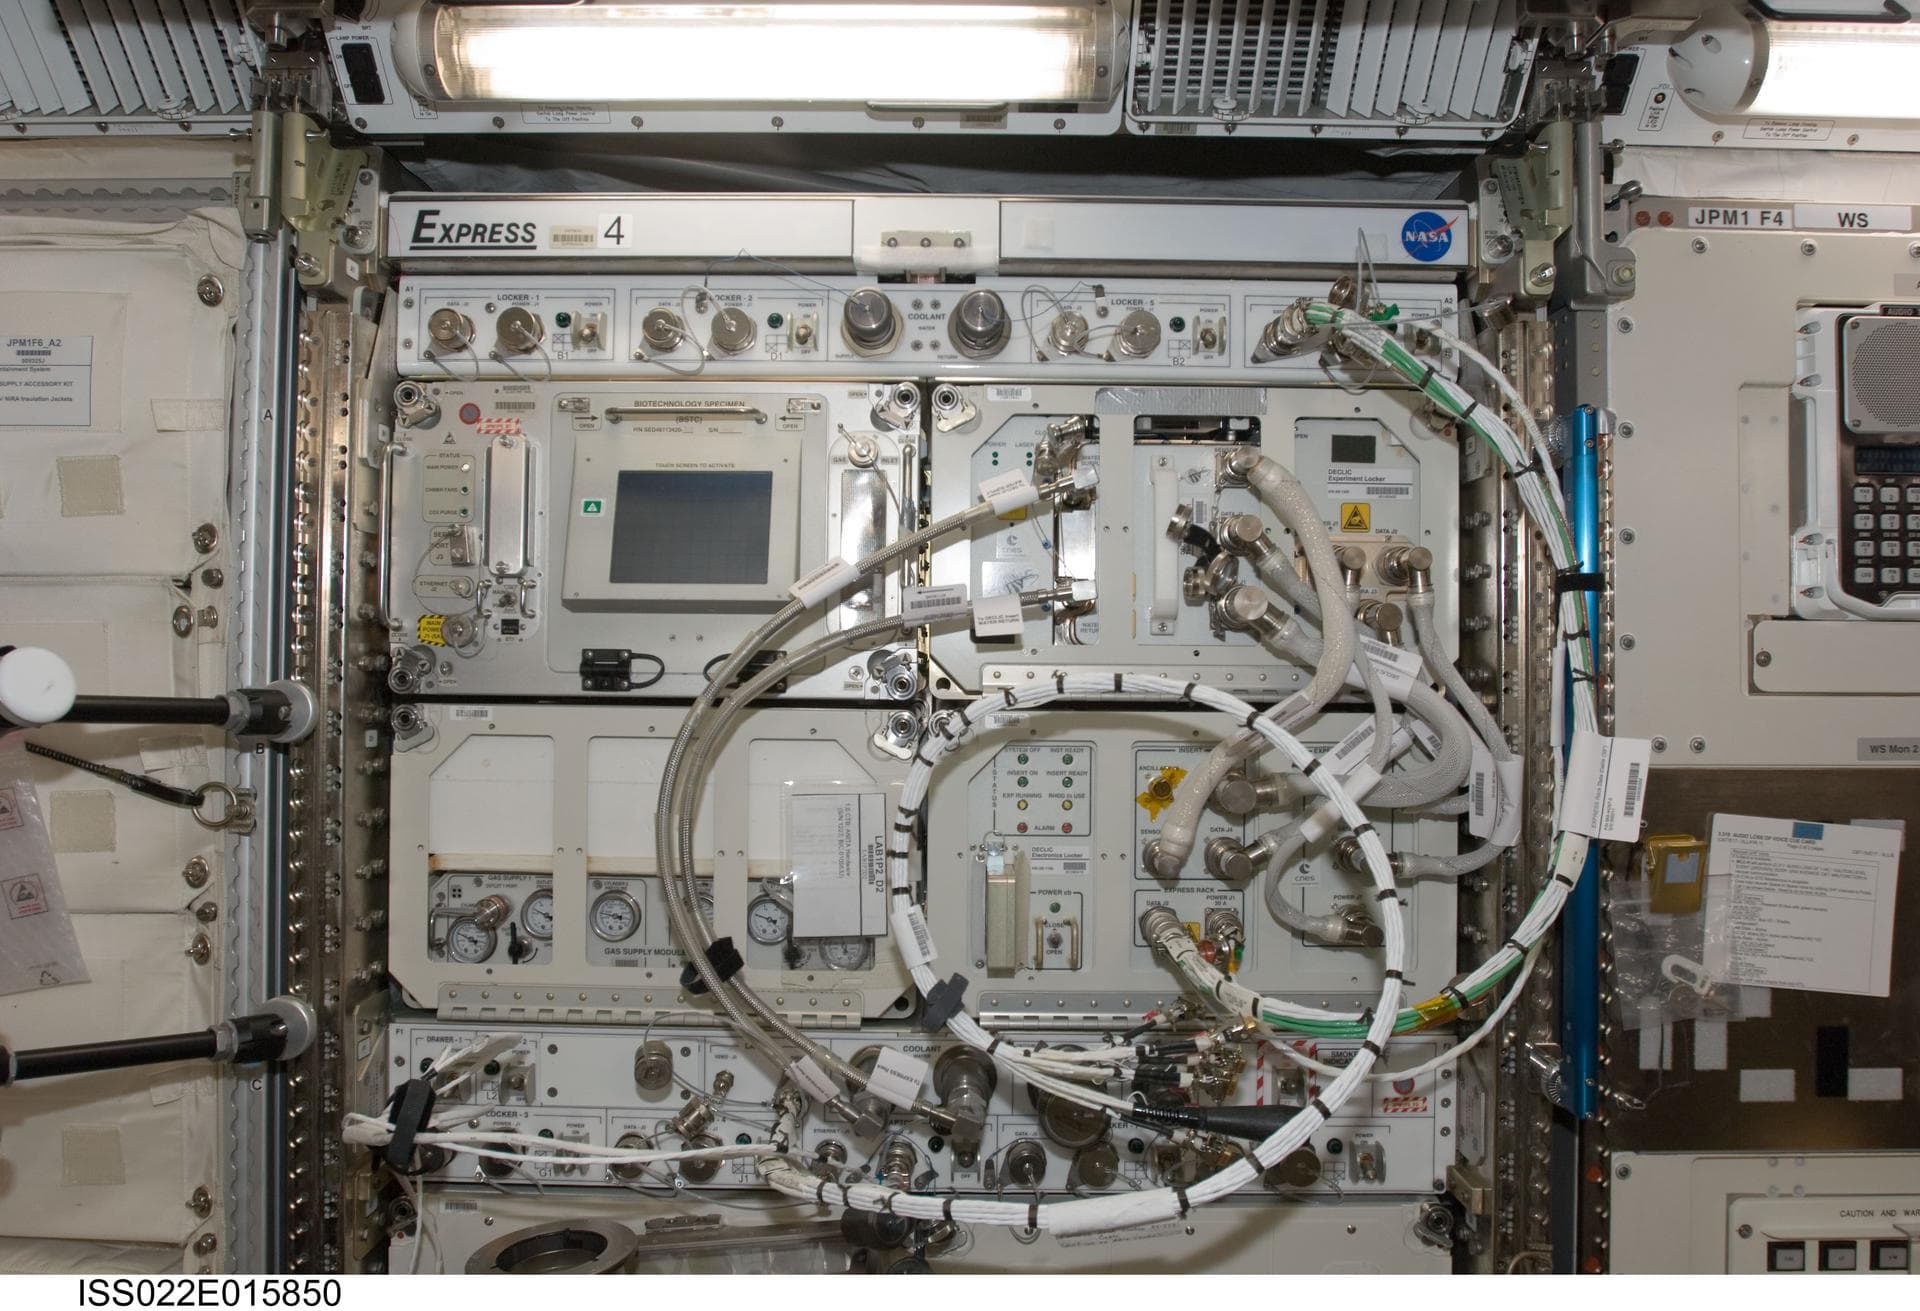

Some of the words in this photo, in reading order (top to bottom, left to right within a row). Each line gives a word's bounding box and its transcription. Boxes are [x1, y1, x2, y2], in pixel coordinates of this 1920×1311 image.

[1695, 209, 1748, 226] JPM1
[1760, 210, 1784, 226] F4
[1838, 212, 1869, 228] WS
[411, 209, 537, 244] EXPRESS
[604, 216, 625, 245] 4
[1406, 230, 1449, 244] NASA
[748, 294, 753, 302] 2
[6, 338, 62, 349] JPM1F6_A2
[558, 352, 569, 360] B1
[770, 352, 783, 361] D1
[1172, 357, 1185, 367] B2
[634, 400, 702, 408] BIOTECHNOLOGY
[704, 400, 745, 408] SPECIMEN
[264, 409, 273, 421] A
[675, 416, 703, 424] (BSTC)
[256, 743, 265, 754] B
[1870, 745, 1887, 754] WS
[1889, 745, 1910, 754] Mon
[1913, 745, 1920, 754] 2
[874, 835, 884, 894] LAB1P2_D2
[252, 1079, 262, 1091] C
[738, 1174, 749, 1184] J1
[1840, 1210, 1874, 1218] CAUTION
